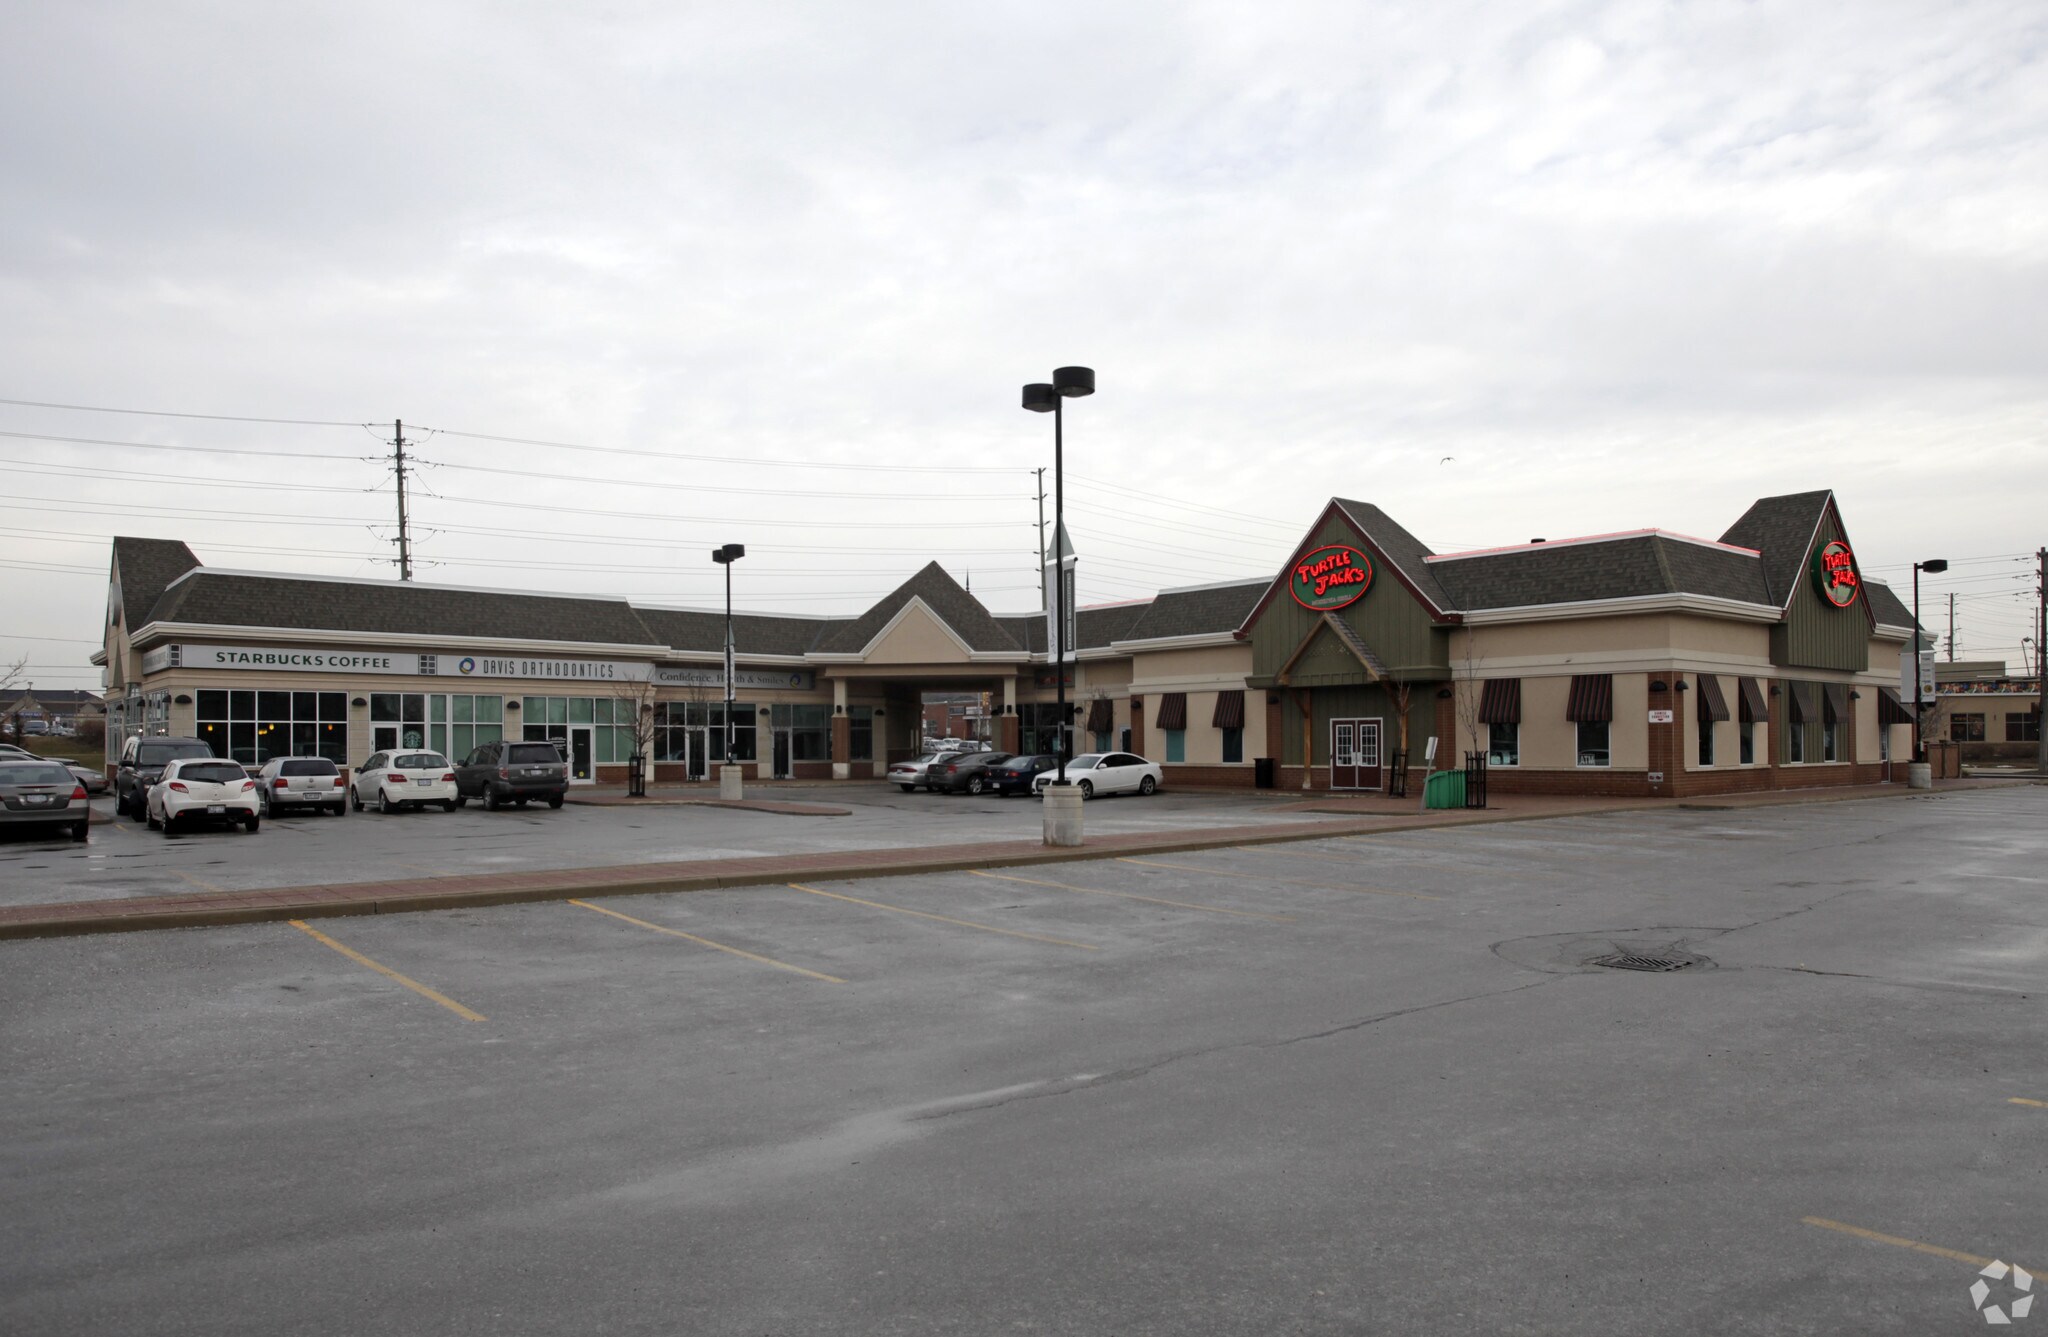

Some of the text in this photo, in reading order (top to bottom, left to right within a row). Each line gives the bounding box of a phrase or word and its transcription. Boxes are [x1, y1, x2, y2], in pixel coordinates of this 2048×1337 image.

[1298, 551, 1351, 583] TURTLE
[1825, 552, 1850, 571] TURTLE
[1314, 568, 1365, 595] JACK'S
[216, 651, 391, 668] STARBUCKS COFFEE
[659, 671, 714, 684] Confidence,
[747, 675, 754, 684] &
[756, 675, 785, 685] Smiles
